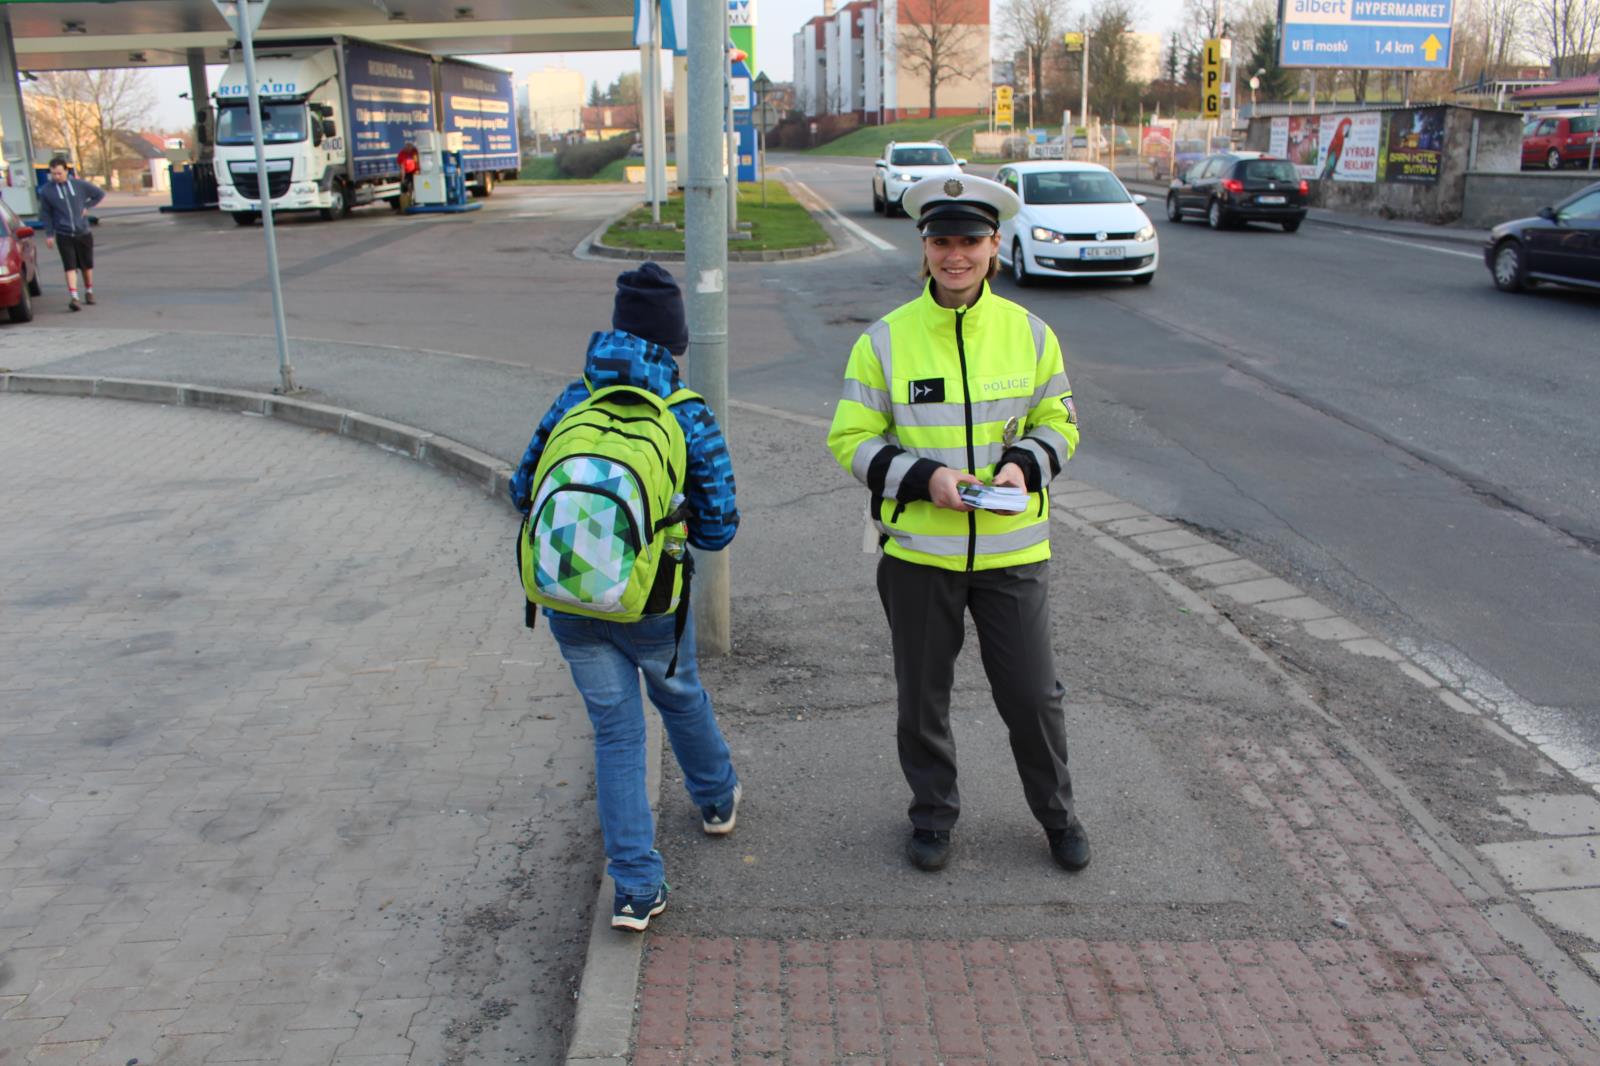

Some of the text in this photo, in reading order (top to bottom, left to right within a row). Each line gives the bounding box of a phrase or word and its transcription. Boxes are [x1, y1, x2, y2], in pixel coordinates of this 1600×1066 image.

[1295, 0, 1446, 18] albert HYPERMARKET
[1291, 39, 1300, 51] U
[1374, 40, 1415, 54] 1,4 km
[1206, 46, 1218, 113] LPG
[984, 378, 1030, 392] POLICIE
